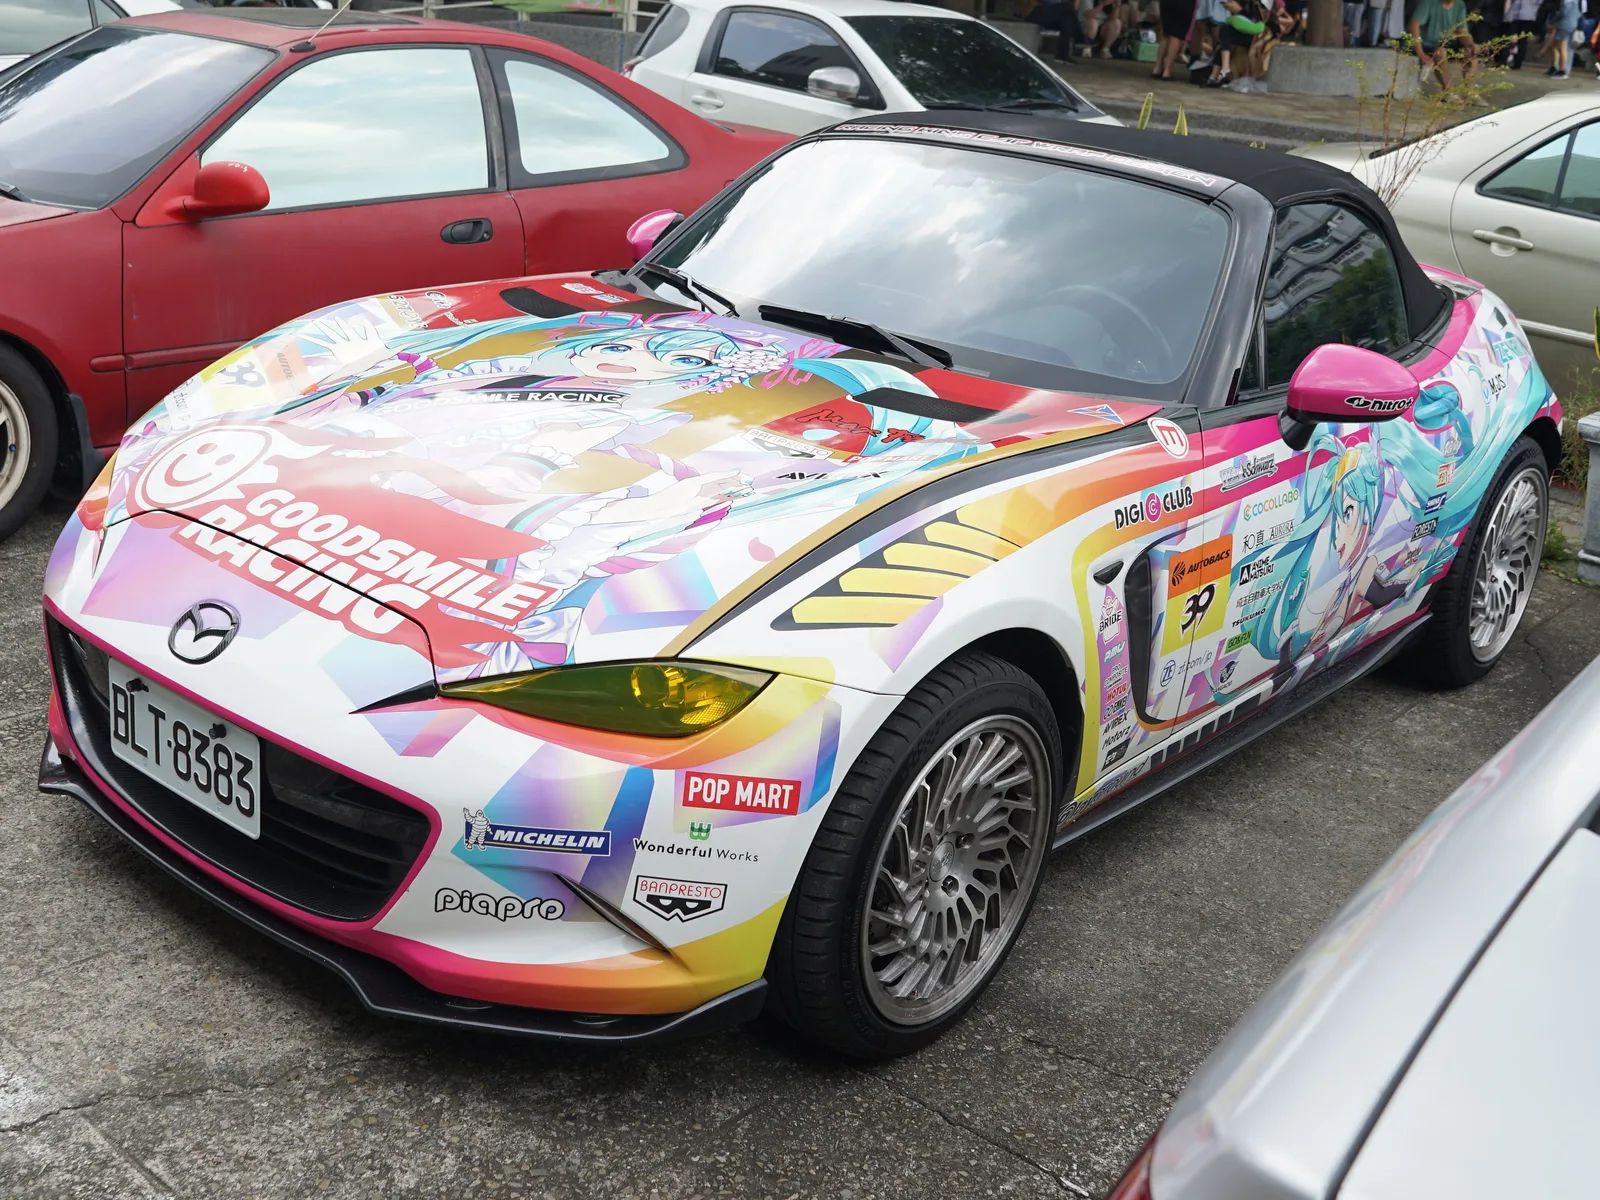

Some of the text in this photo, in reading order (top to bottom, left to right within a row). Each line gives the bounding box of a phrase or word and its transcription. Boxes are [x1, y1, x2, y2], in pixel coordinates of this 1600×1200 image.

[373, 391, 624, 416] GOODSMILE RACING
[748, 430, 830, 458] BANPRESTO
[1114, 503, 1144, 530] DIGI
[1163, 486, 1193, 512] CLUB
[1252, 489, 1299, 516] COCOLLABO
[1269, 519, 1295, 541] AURORA
[245, 488, 560, 625] GOODSMILE
[1186, 549, 1230, 574] AUTOBACS
[1252, 556, 1270, 572] ANIME
[177, 509, 432, 636] RACING
[1249, 564, 1274, 582] MATSURI
[1100, 610, 1122, 632] BRIDE
[1180, 583, 1219, 638] 39
[1232, 608, 1266, 627] TSUKUMO
[1107, 682, 1127, 701] MOTUL
[1102, 709, 1131, 736] AVIREX
[687, 775, 794, 810] POP MART
[493, 829, 606, 849] MICHELIN
[632, 838, 760, 863] Wonderful Works
[640, 879, 722, 899] BANPRESTO
[434, 887, 566, 922] piapro
